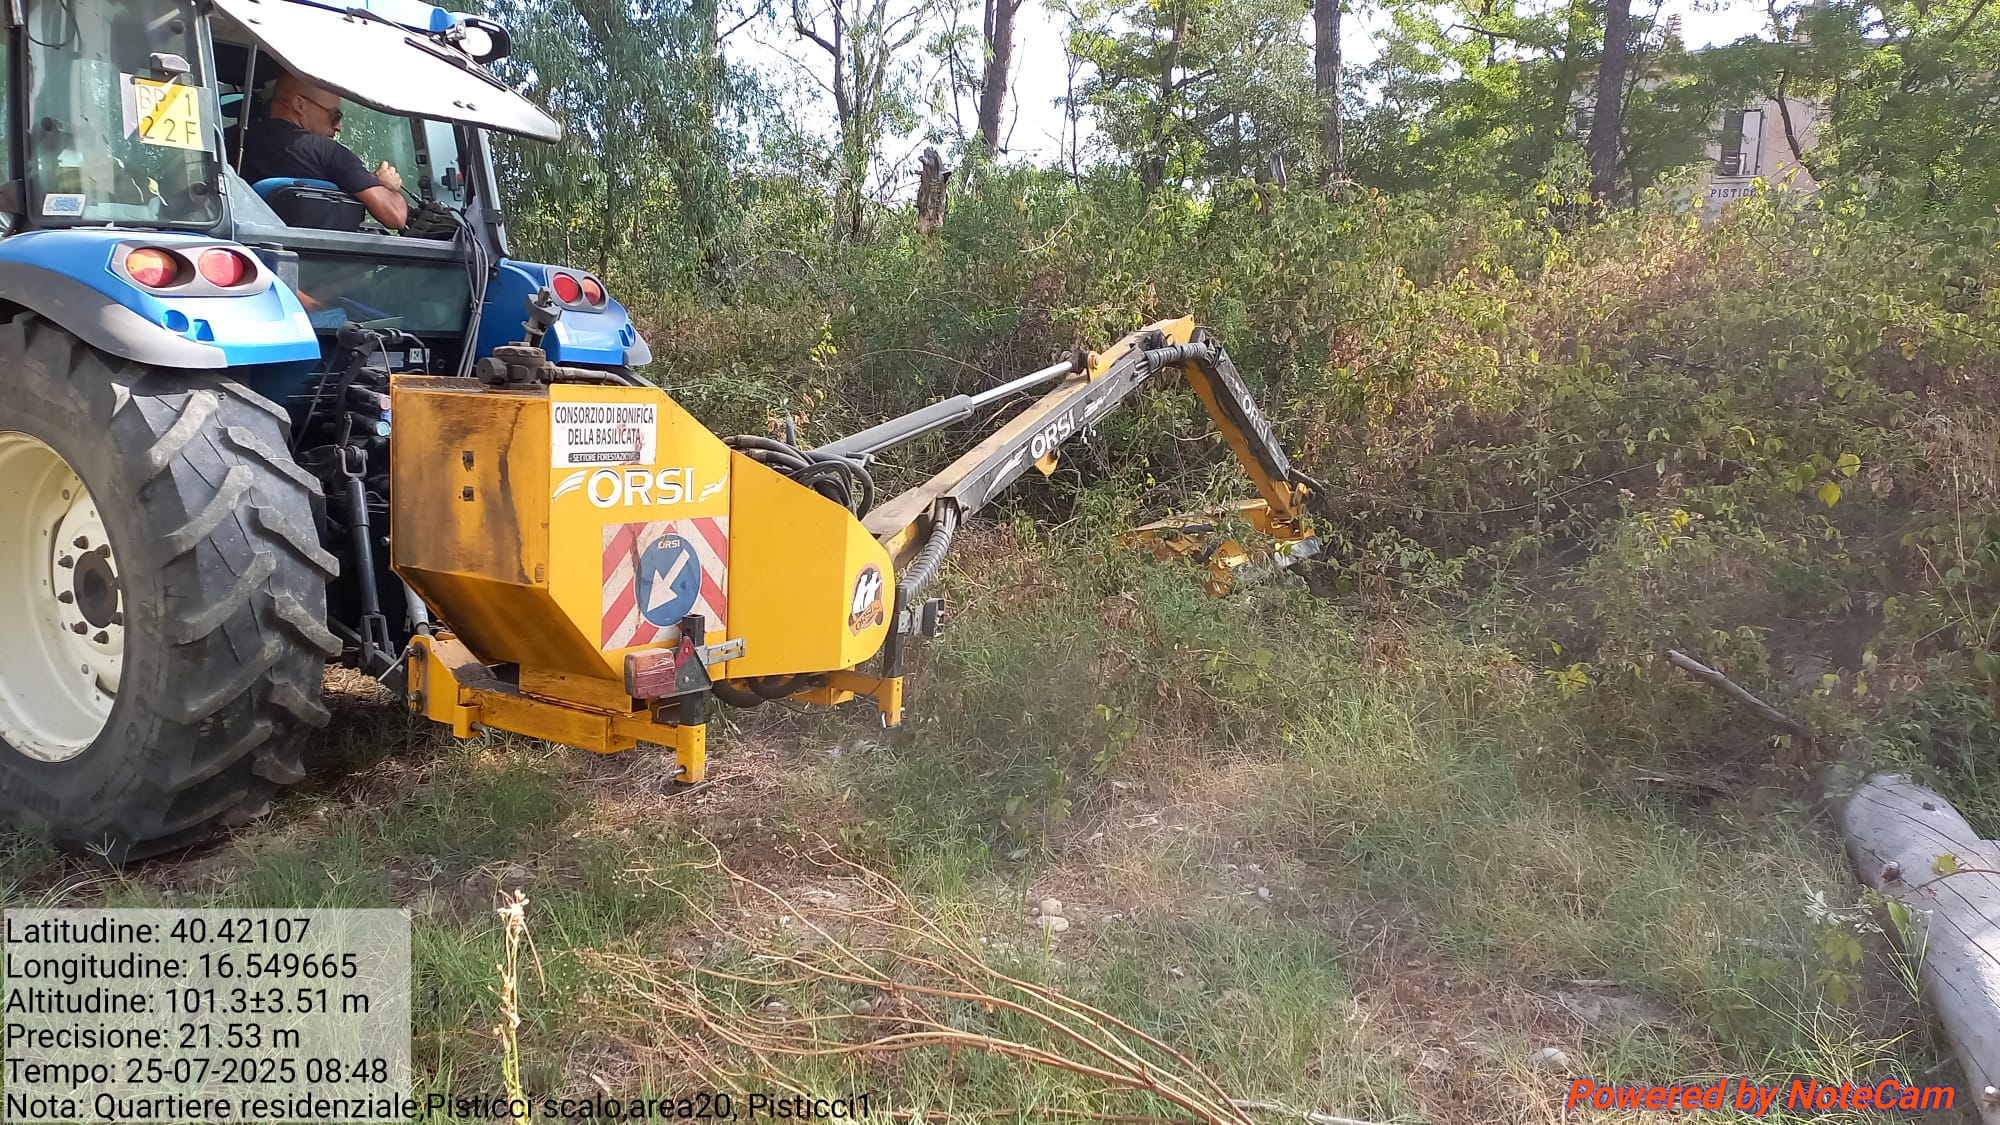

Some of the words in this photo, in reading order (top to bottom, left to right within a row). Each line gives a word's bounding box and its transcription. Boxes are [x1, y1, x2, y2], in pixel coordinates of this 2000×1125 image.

[139, 86, 166, 112] BP
[555, 406, 604, 424] CONSORZIO
[606, 407, 615, 424] DI
[616, 407, 654, 424] BONIFICA
[1243, 394, 1268, 442] ORSI
[568, 428, 594, 446] DELLA
[596, 428, 641, 445] BASILICATA
[1031, 408, 1076, 459] ORSI
[573, 453, 596, 462] SETTORE
[587, 467, 694, 509] ORSI
[658, 539, 680, 549] ORSI
